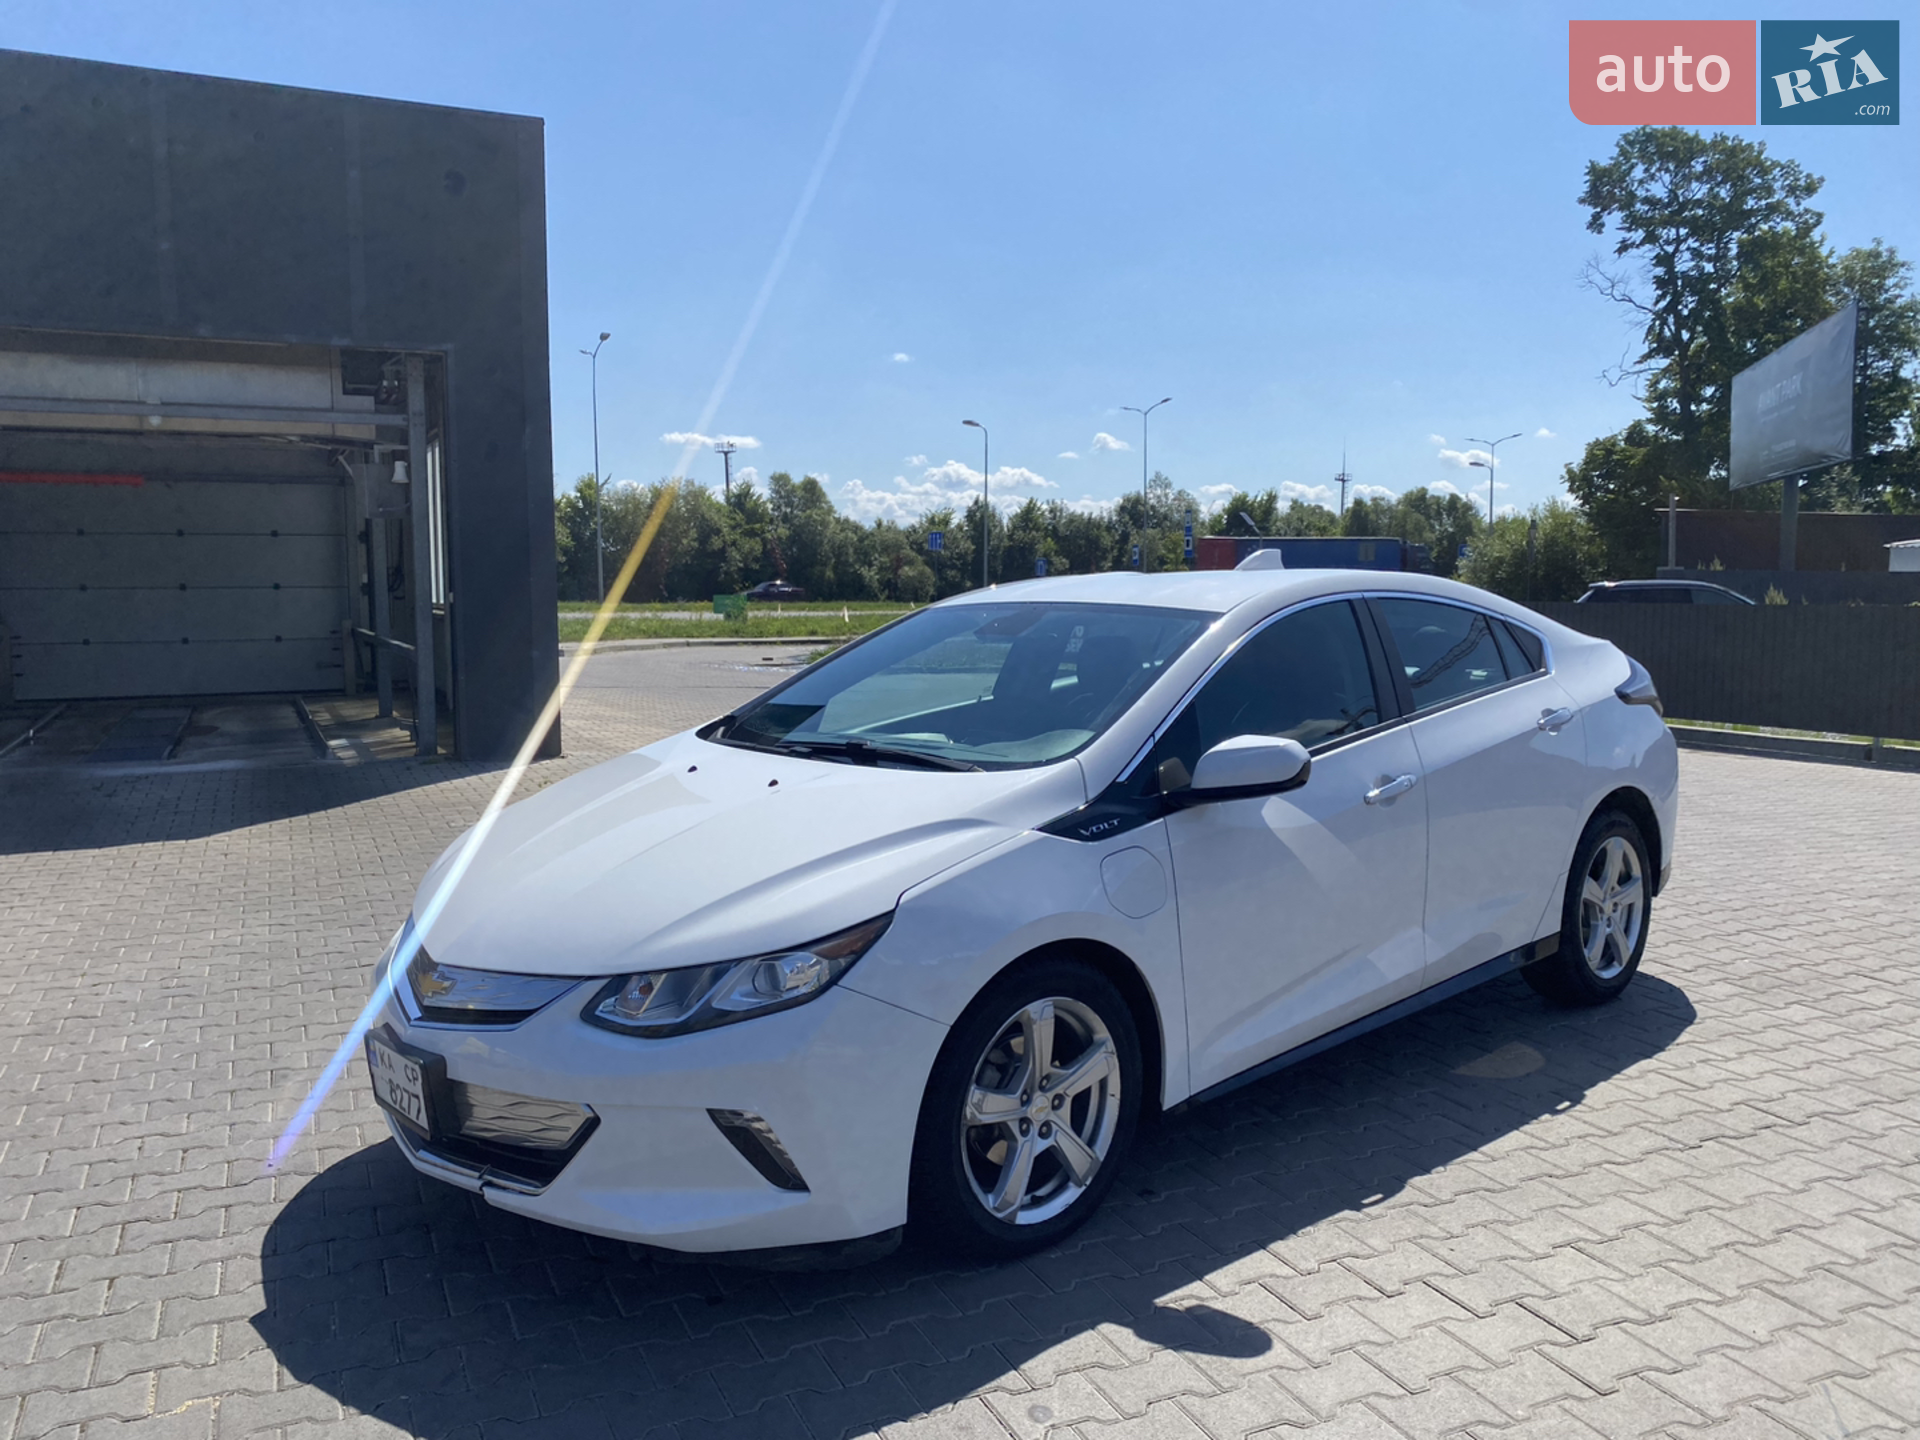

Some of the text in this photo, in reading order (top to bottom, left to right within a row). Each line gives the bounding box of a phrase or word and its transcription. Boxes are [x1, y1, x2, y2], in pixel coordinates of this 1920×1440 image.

[1077, 818, 1120, 836] VOLT
[378, 1047, 420, 1086] KA CP
